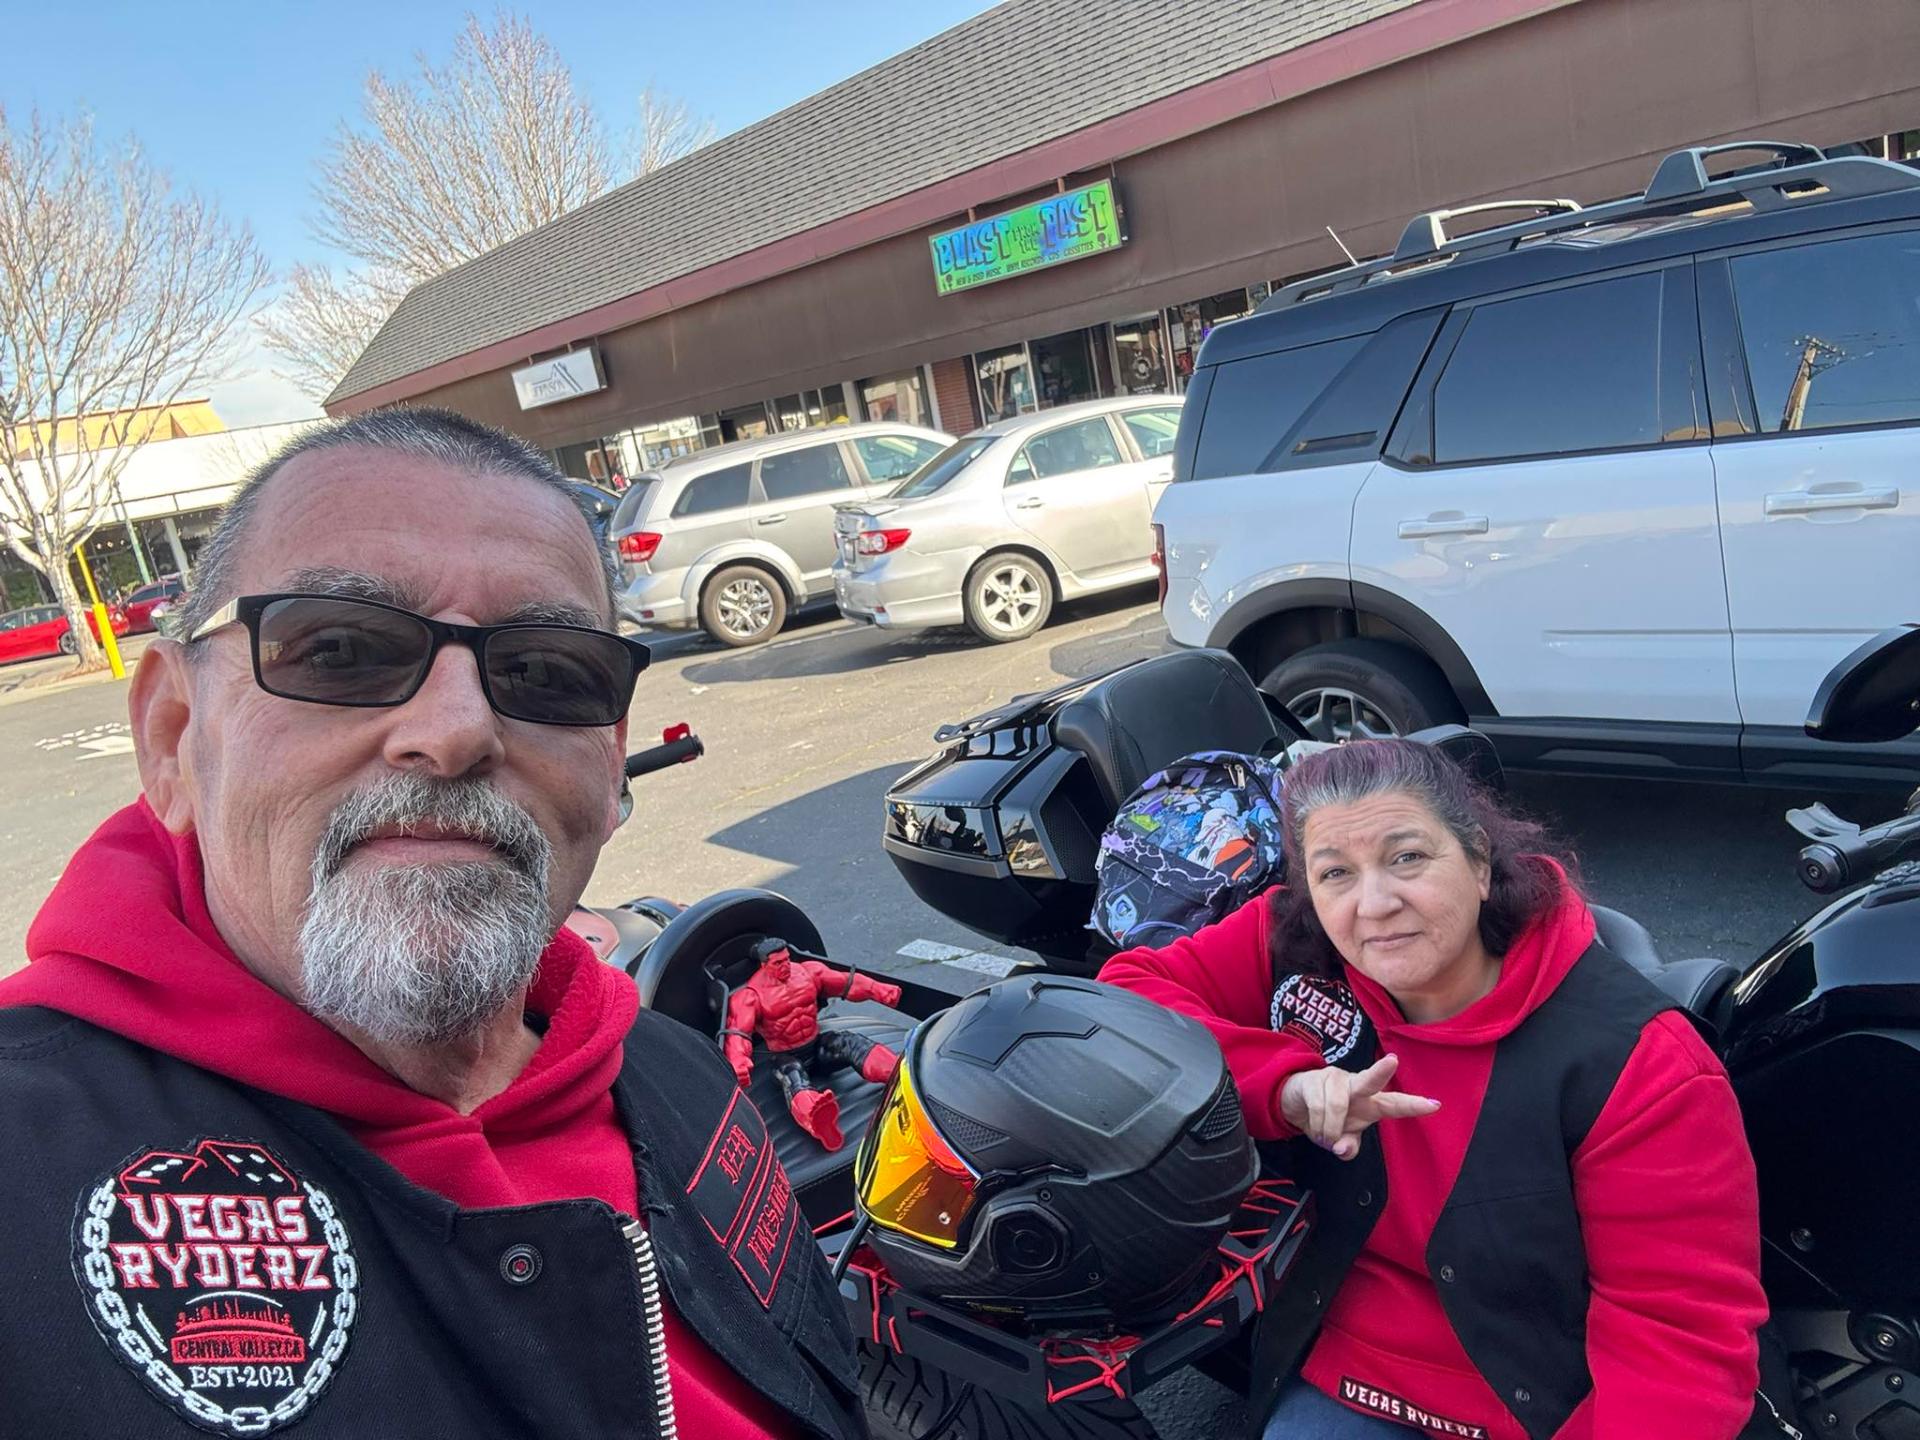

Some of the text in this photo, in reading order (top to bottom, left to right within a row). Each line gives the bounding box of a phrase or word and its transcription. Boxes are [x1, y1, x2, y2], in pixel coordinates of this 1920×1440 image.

[1039, 190, 1108, 248] PAST
[933, 219, 1011, 275] BLAST
[1282, 992, 1350, 1043] RYDERZ
[1297, 981, 1354, 1026] VEGAS
[116, 1194, 309, 1242] VEGAS
[108, 1243, 332, 1290] RYDERZ
[178, 1338, 233, 1359] CENTRAL
[188, 1365, 295, 1388] EST-2021
[1344, 1381, 1485, 1440] VEGAS RYDERZ
